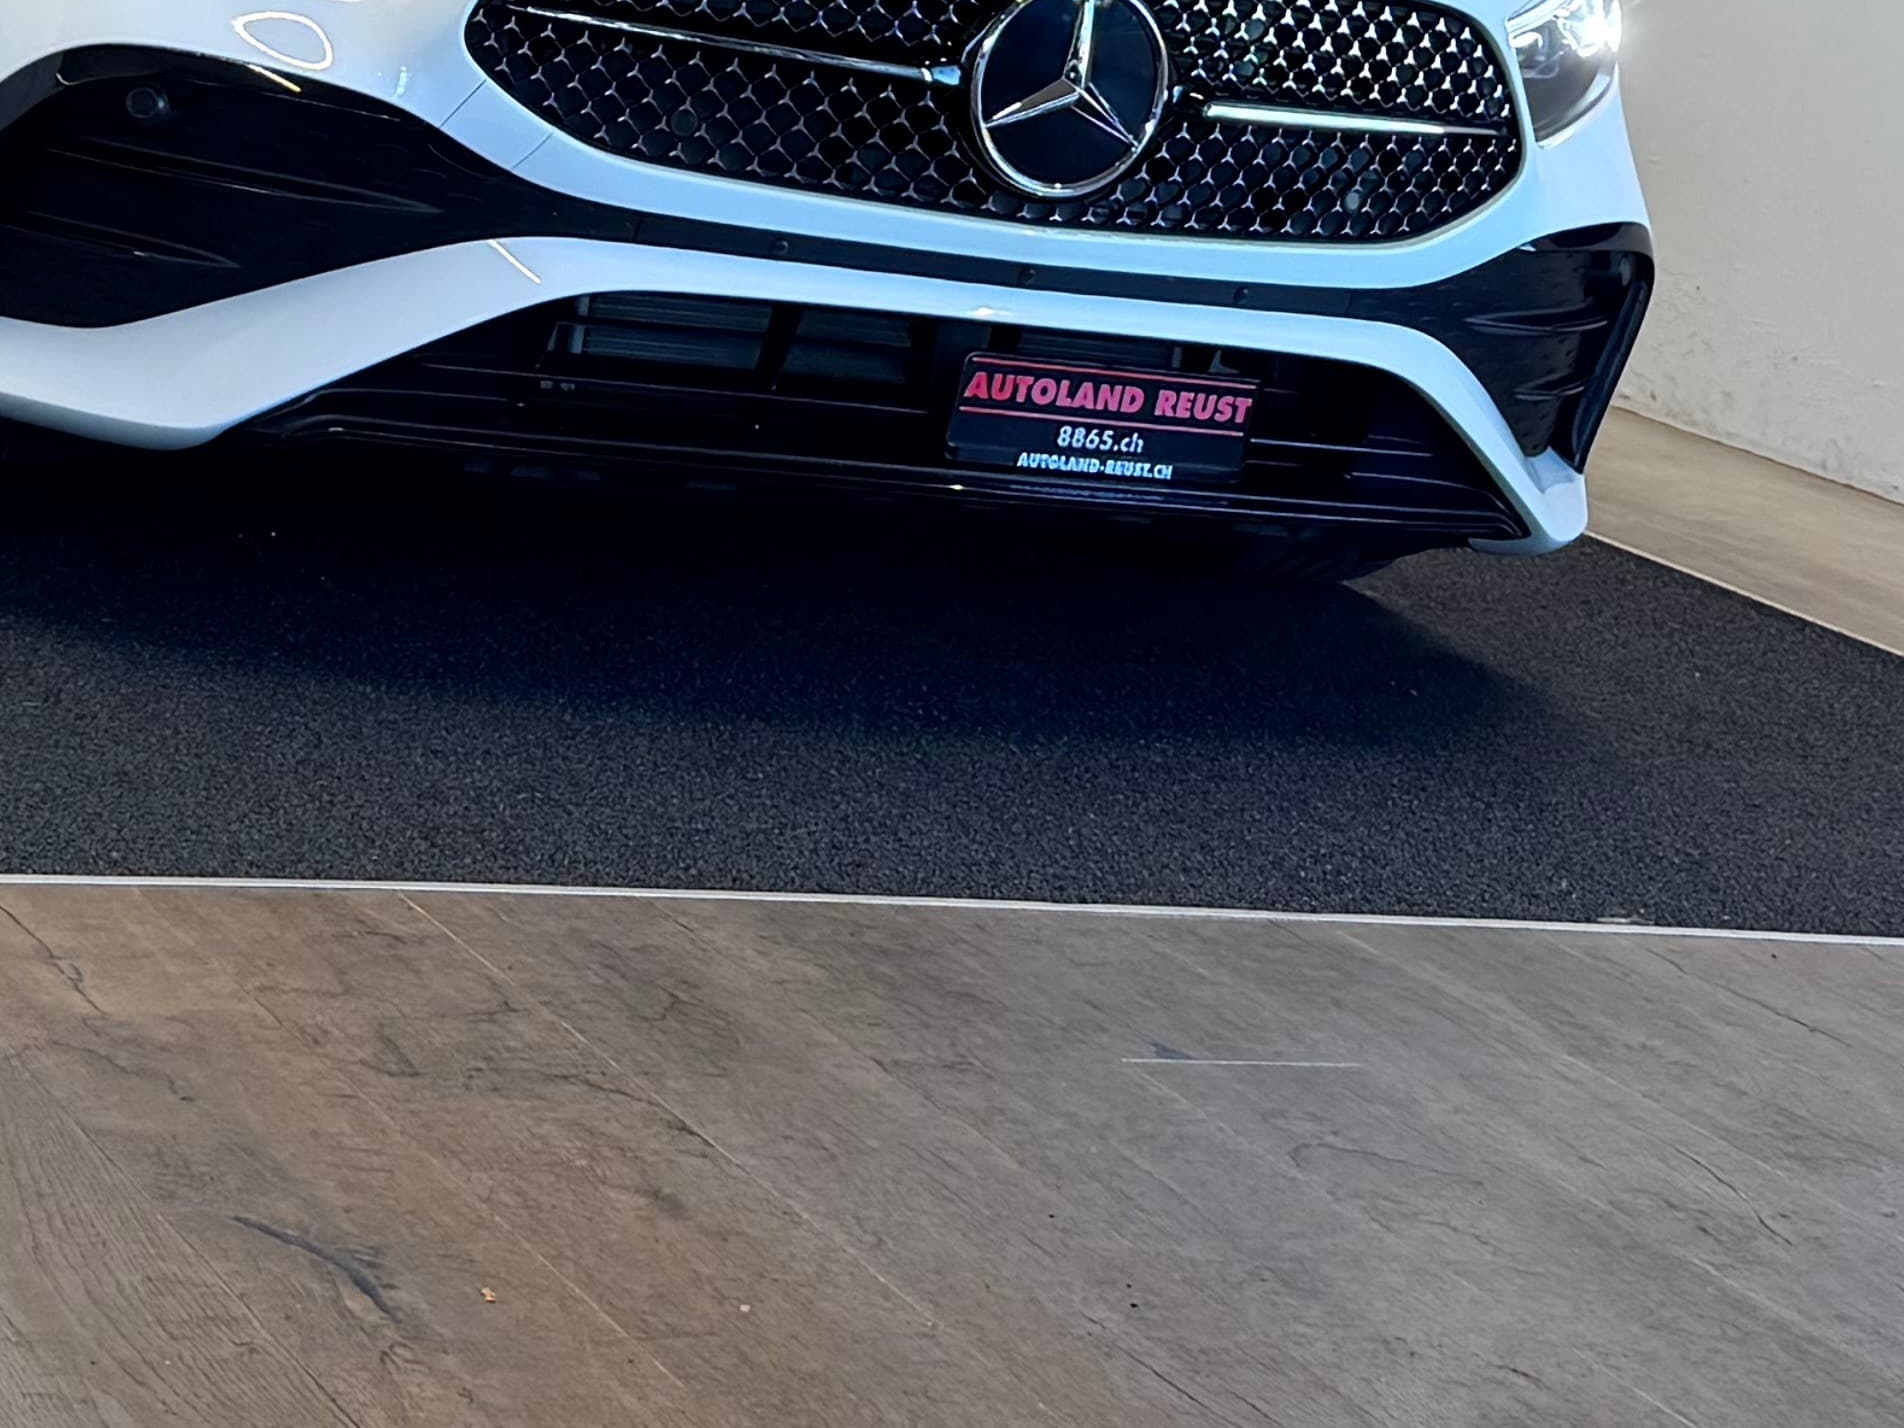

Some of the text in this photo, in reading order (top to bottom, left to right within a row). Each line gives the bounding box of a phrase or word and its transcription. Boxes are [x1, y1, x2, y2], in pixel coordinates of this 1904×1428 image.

[963, 370, 1253, 424] AUTOLAND REUST
[1056, 425, 1145, 454] 8865.ch
[1016, 451, 1174, 481] AUTOLAND-REUST.CH
